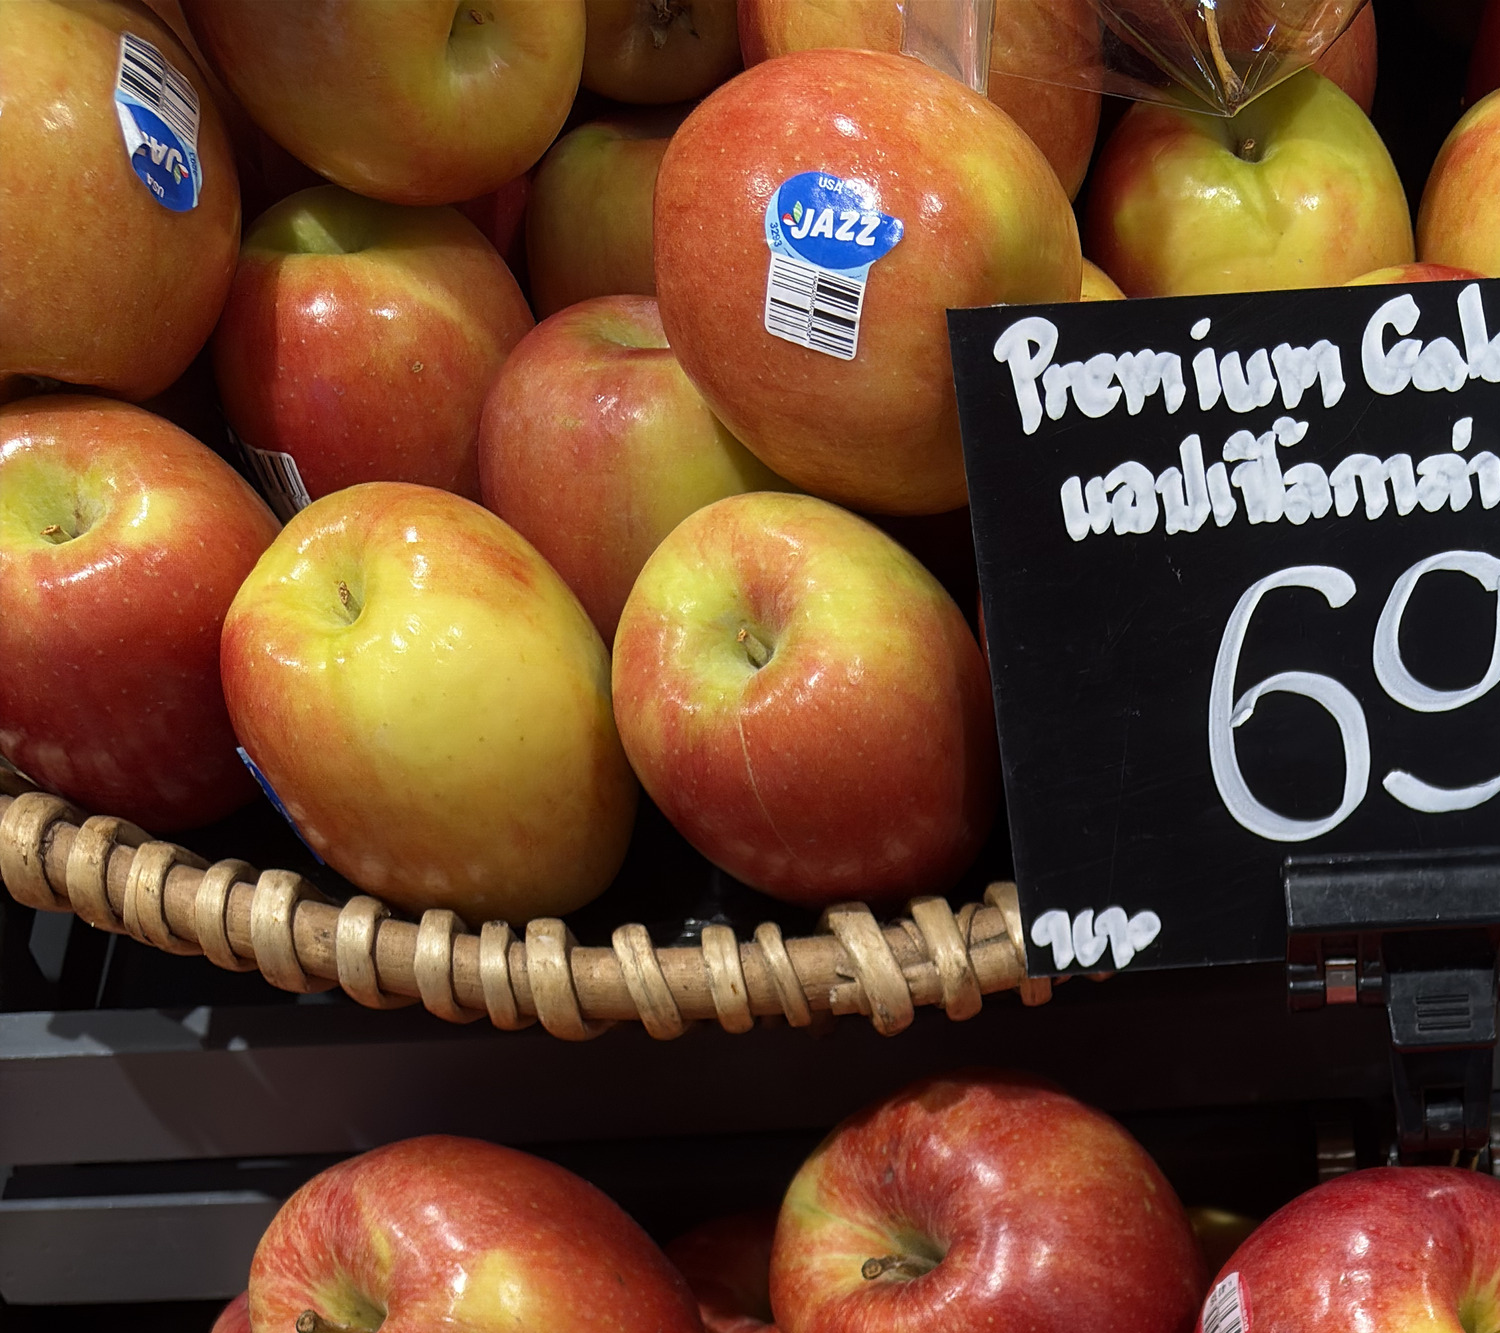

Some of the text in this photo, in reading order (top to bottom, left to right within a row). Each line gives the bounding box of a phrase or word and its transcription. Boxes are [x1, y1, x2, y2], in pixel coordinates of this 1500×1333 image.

[146, 172, 165, 198] USA
[818, 177, 844, 194] USA
[770, 222, 782, 247] 3293
[791, 207, 881, 246] JAZZ
[994, 317, 1346, 435] Premium
